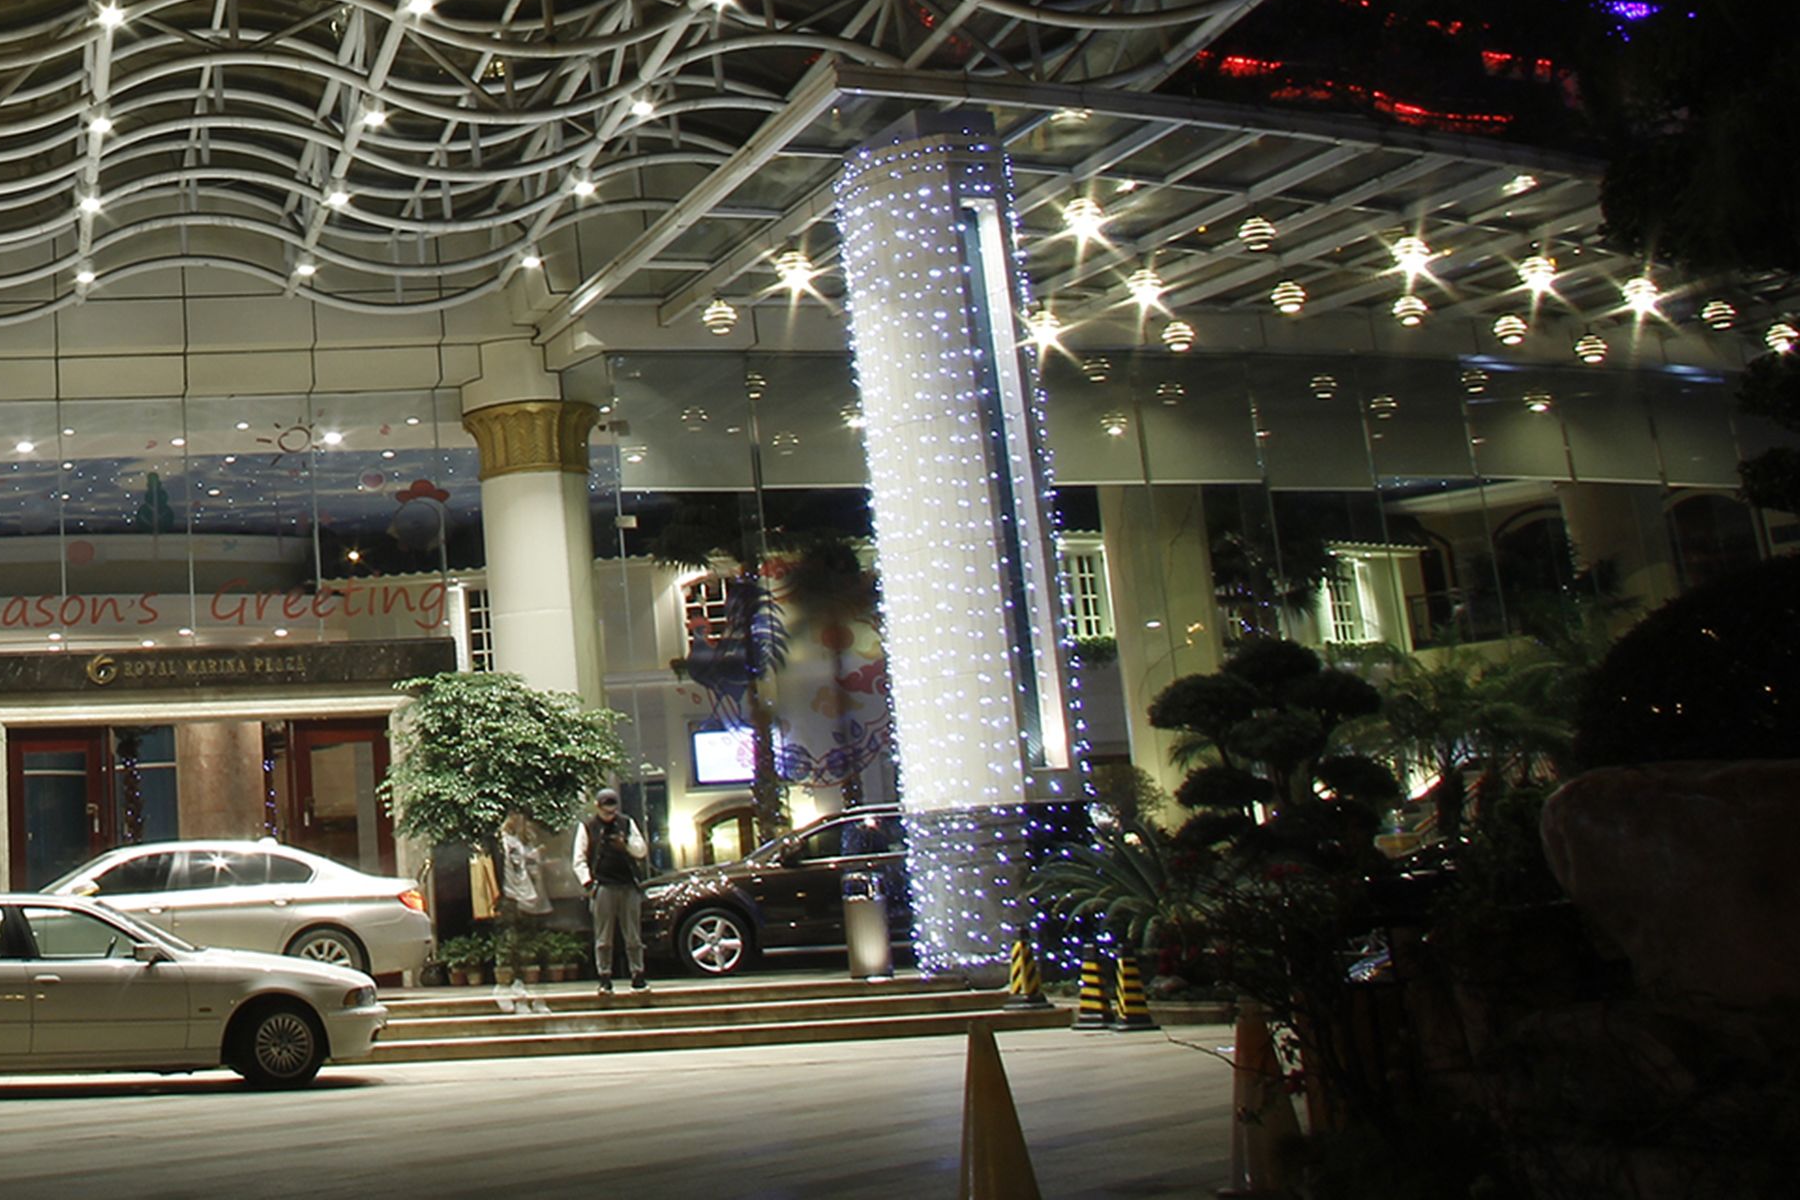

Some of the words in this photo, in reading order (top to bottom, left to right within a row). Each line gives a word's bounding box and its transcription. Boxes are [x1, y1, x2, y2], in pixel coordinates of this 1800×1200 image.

[210, 569, 447, 630] Greeting
[123, 659, 176, 677] ROYAL
[186, 657, 248, 675] MARINA
[254, 654, 306, 673] PLAZA
